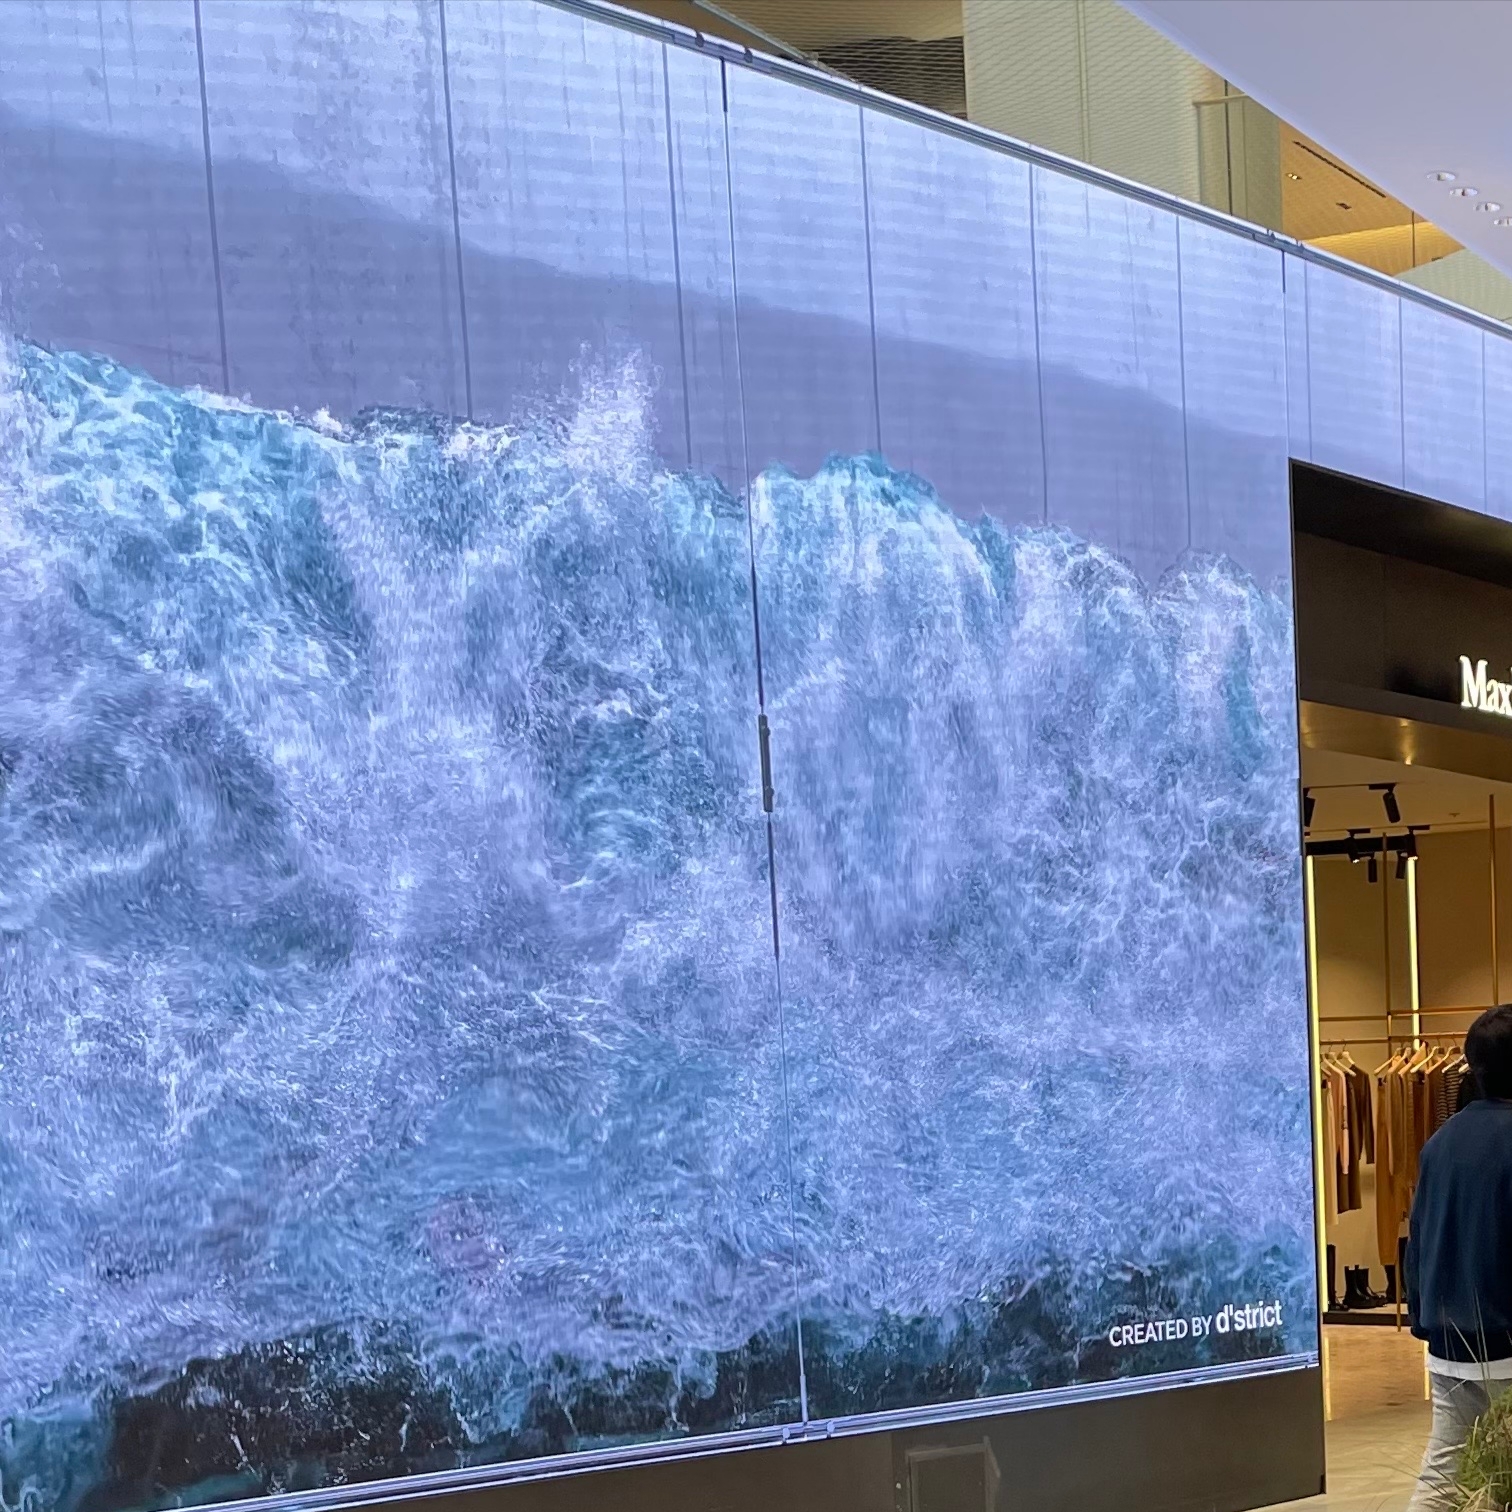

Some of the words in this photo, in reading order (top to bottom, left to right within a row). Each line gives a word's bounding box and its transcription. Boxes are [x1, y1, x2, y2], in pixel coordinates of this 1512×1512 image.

[1109, 1318, 1188, 1347] CREATED
[1192, 1315, 1212, 1337] BY
[1215, 1300, 1283, 1333] d'strict
